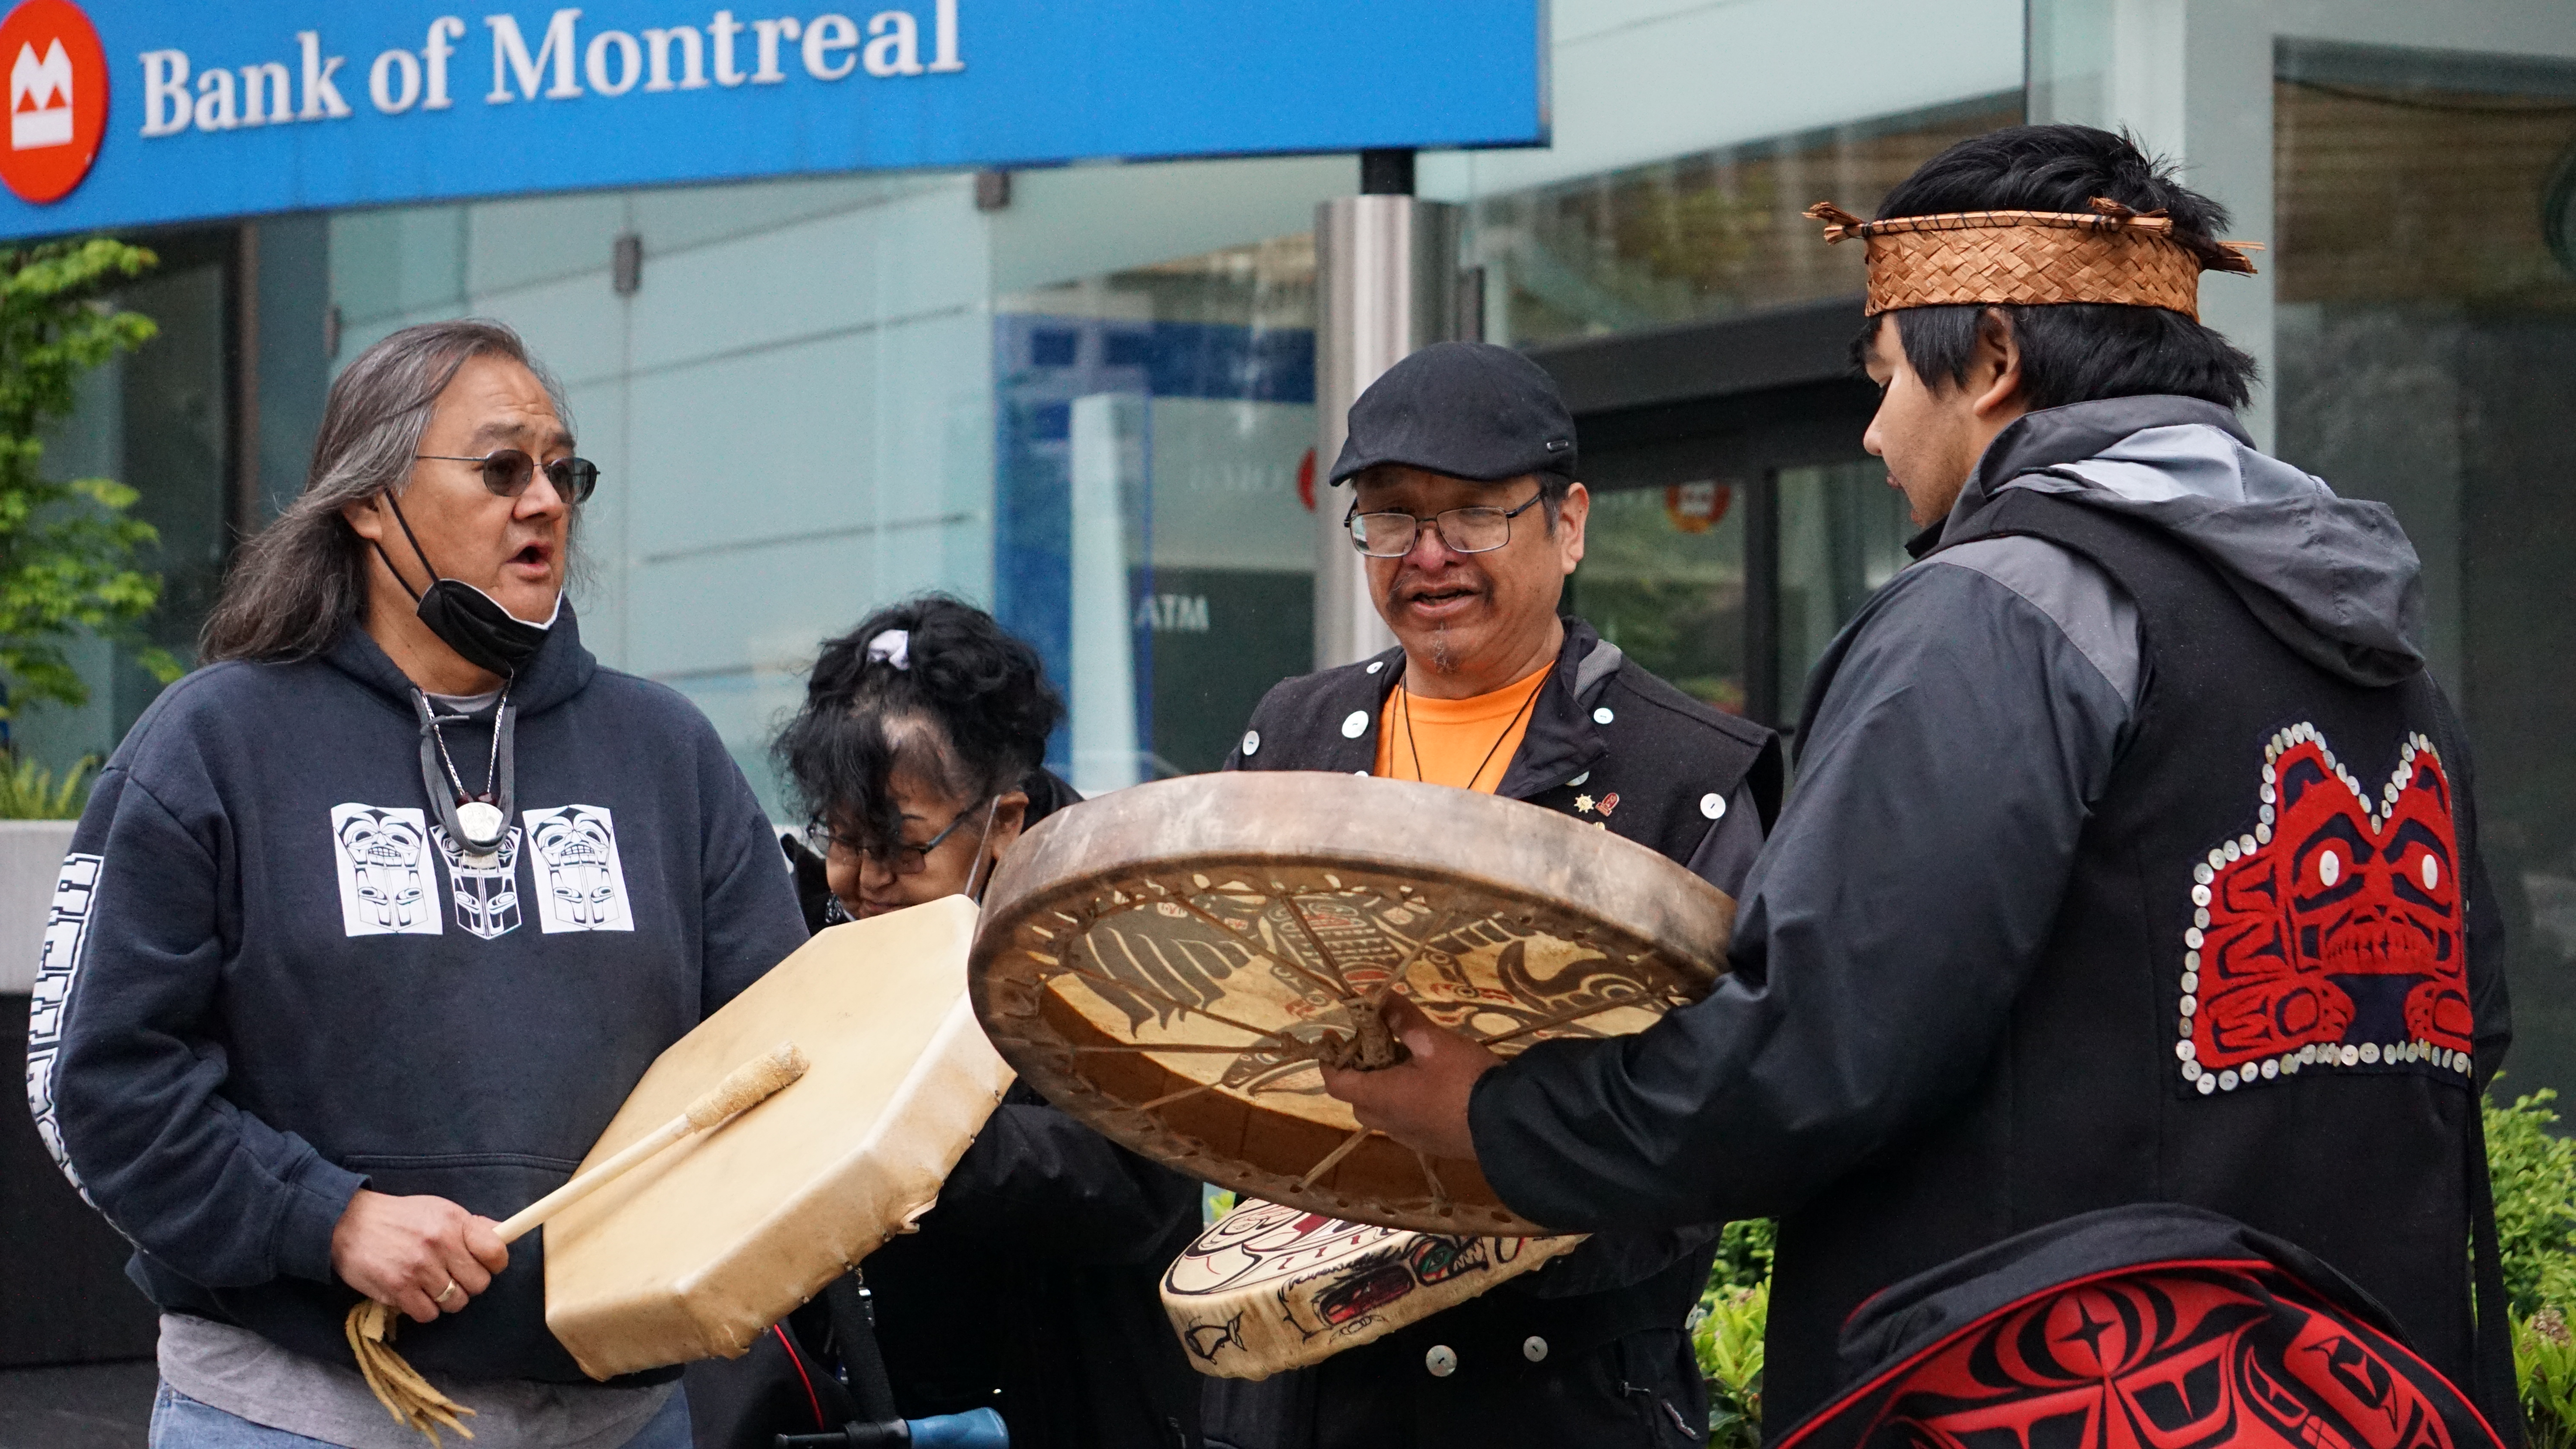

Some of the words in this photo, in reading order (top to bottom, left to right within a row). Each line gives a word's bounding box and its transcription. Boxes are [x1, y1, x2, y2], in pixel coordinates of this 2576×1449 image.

[140, 31, 351, 136] Bank
[368, 16, 465, 112] of
[485, 0, 964, 104] Montreal
[1134, 594, 1210, 634] ATM
